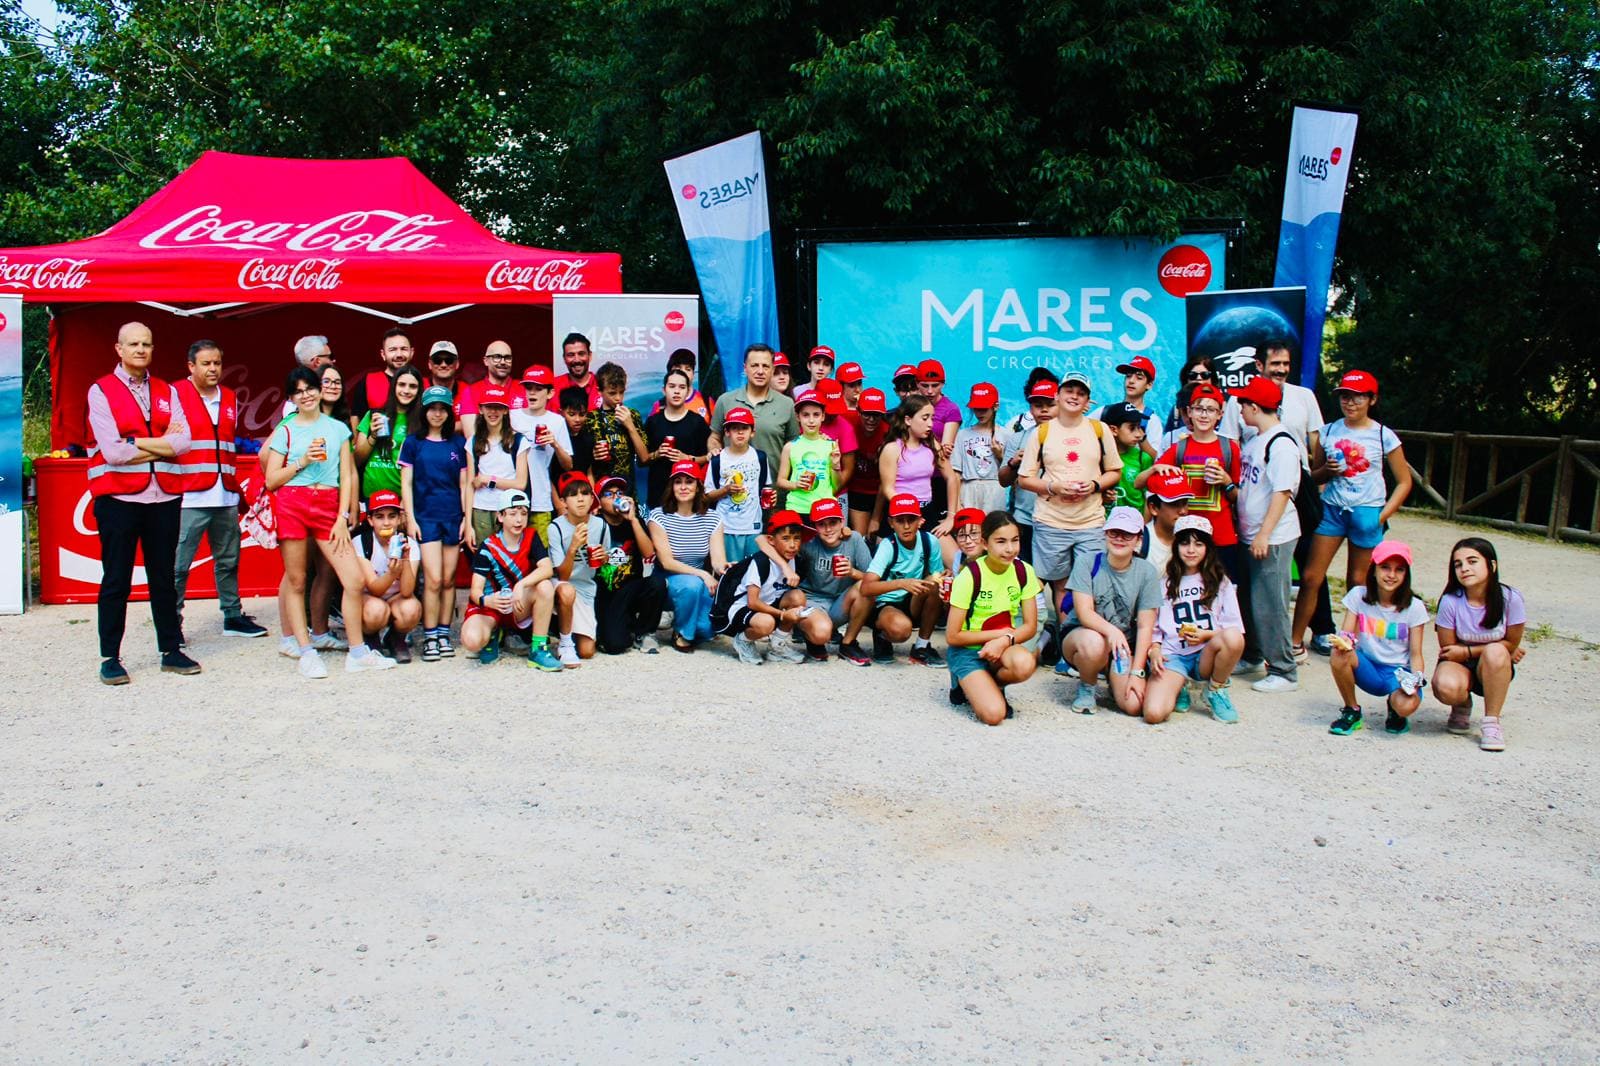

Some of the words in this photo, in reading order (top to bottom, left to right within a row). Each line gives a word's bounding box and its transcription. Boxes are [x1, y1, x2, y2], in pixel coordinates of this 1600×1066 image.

[1298, 154, 1329, 181] MARES
[139, 205, 453, 252] Coca-Cola
[238, 257, 346, 290] Coca-Cola
[485, 259, 589, 291] Coca-Cola
[1161, 262, 1208, 278] Coca-Cola
[921, 287, 1158, 352] MARES
[987, 356, 1113, 370] CIRCULARES
